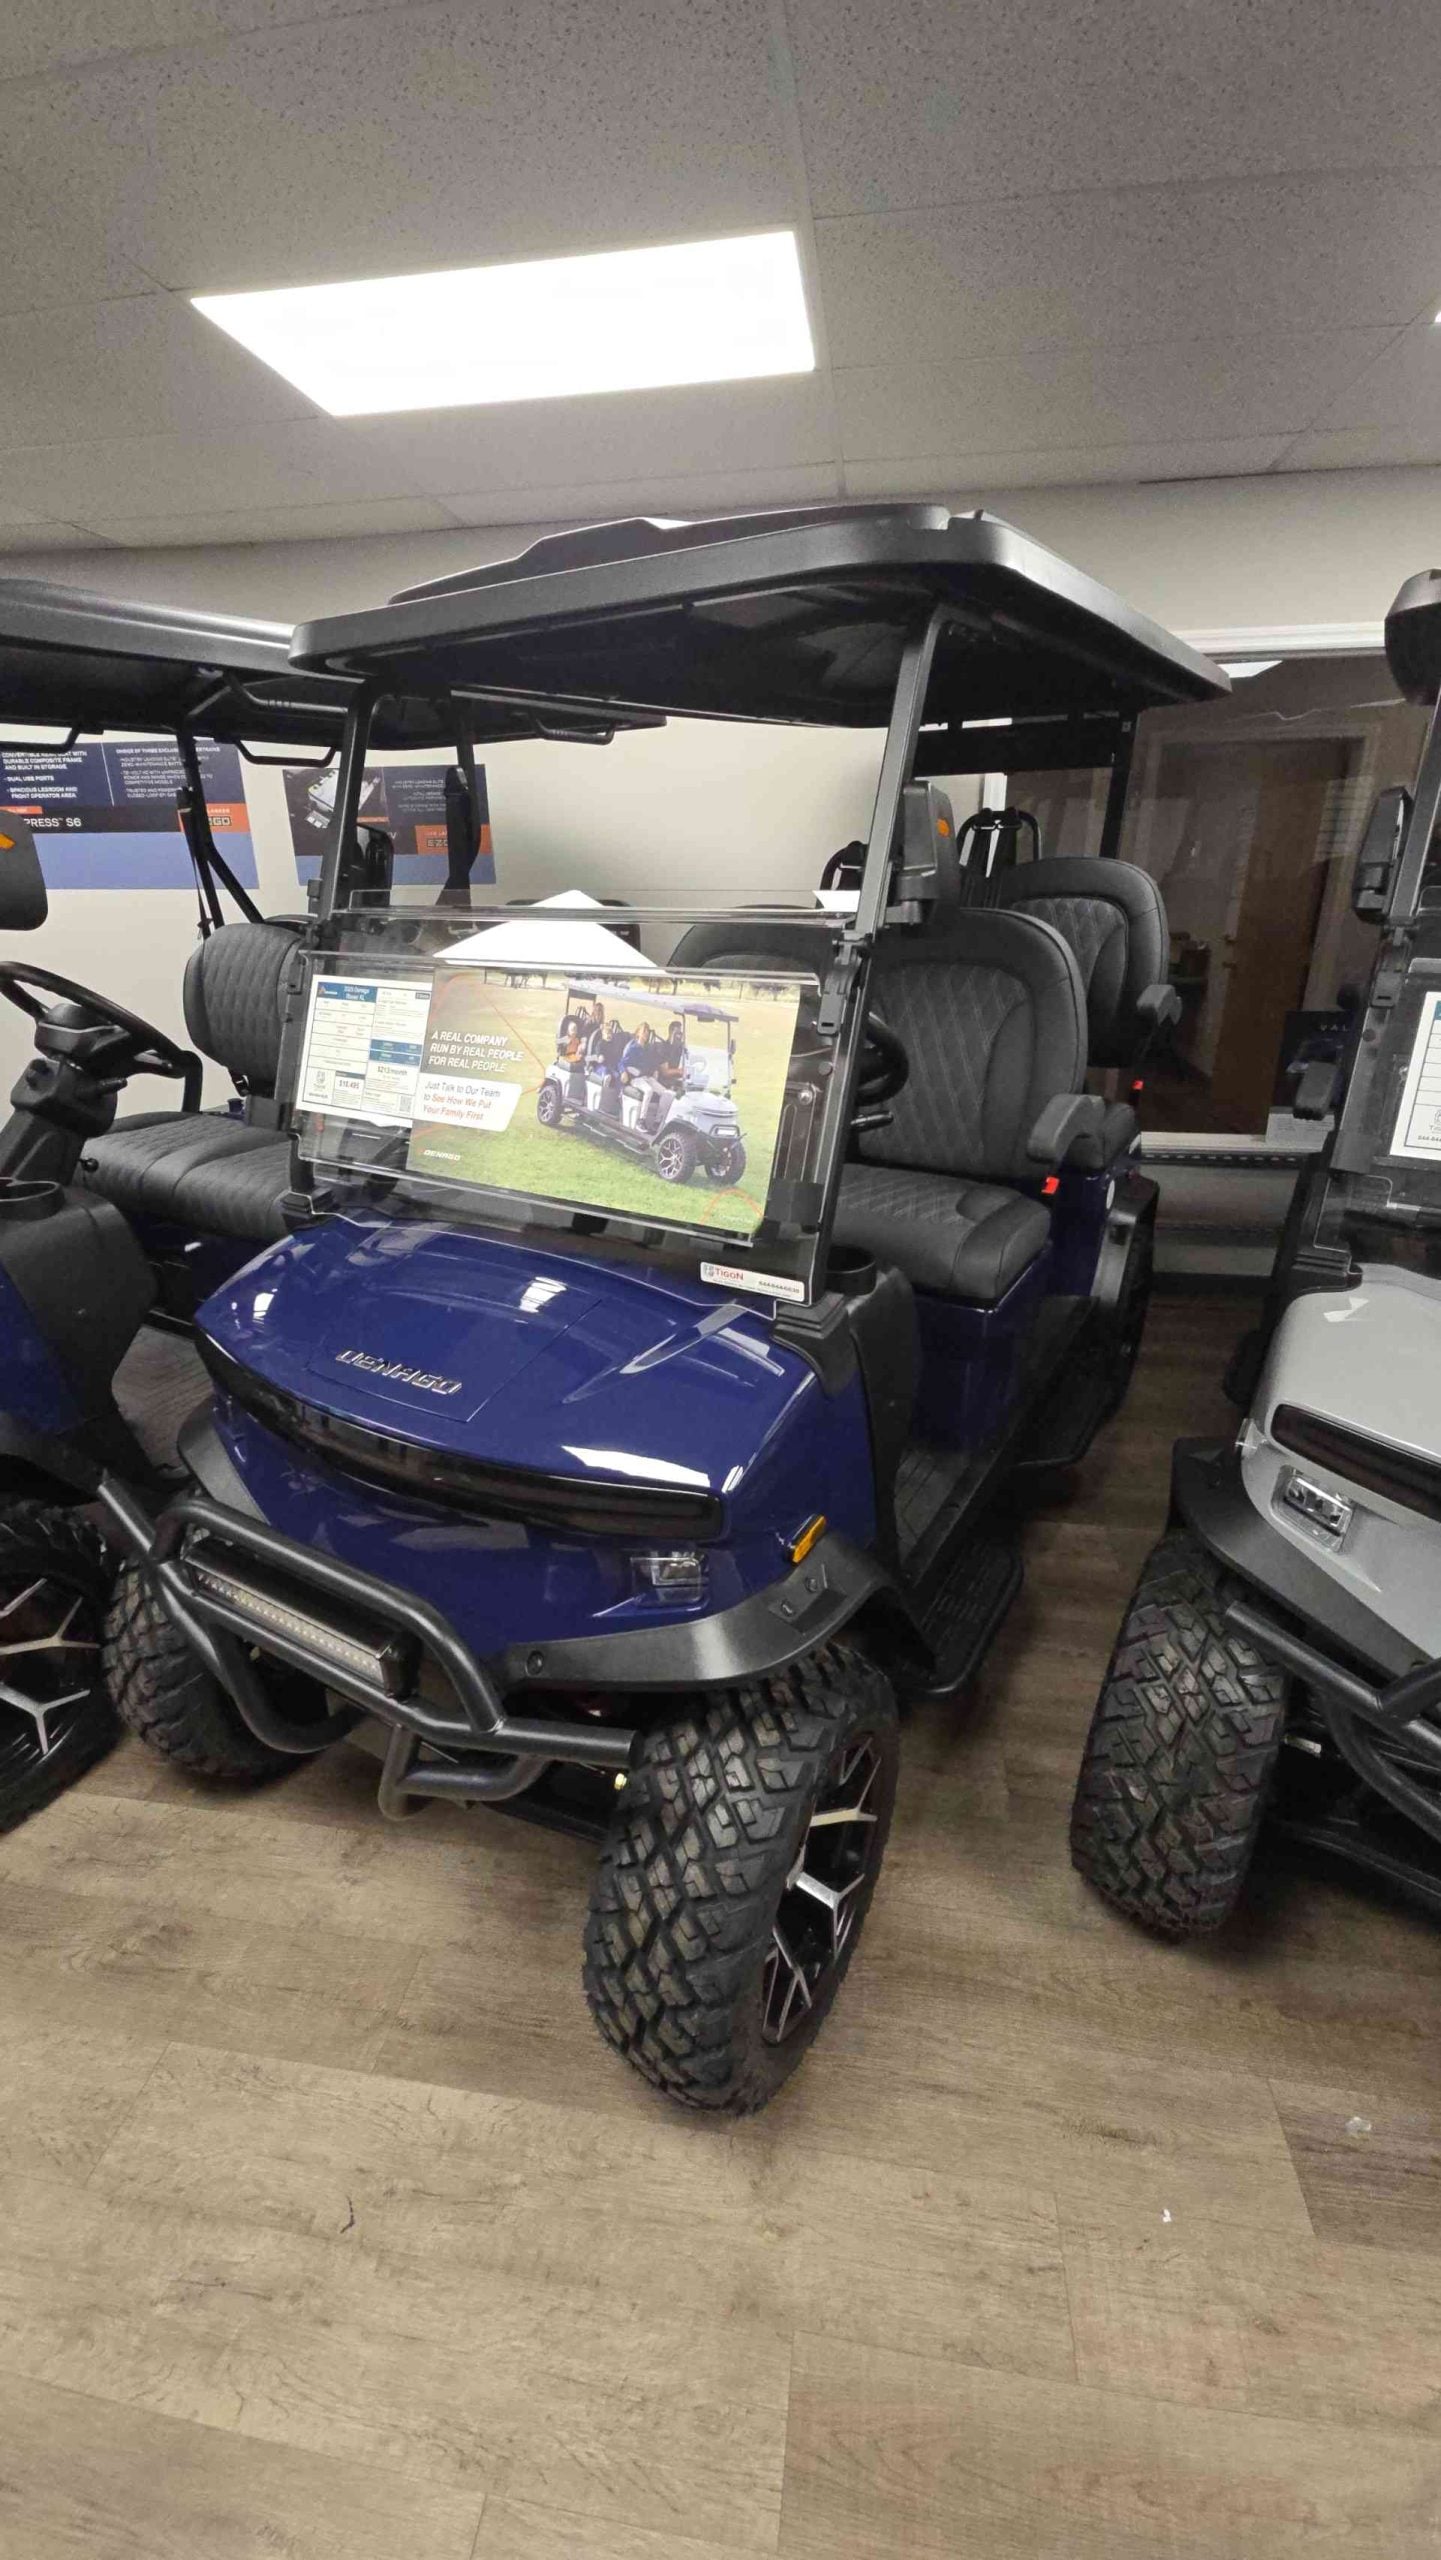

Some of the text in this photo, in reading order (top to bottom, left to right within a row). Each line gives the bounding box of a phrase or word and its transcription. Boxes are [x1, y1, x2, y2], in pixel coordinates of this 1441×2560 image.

[66, 818, 82, 827] S6
[209, 816, 231, 826] GO
[432, 1030, 508, 1047] A REAL COMPANY
[430, 1043, 449, 1053] RUN
[449, 1045, 462, 1055] BY
[462, 1046, 485, 1058] REAL
[487, 1049, 525, 1062] PEOPLE
[428, 1056, 508, 1072] FOR REAL PEOPLE
[424, 1081, 501, 1097] Just Talk to Our Team
[432, 1094, 444, 1103] See
[446, 1095, 463, 1105] How
[465, 1098, 477, 1107] We
[478, 1099, 492, 1108] Put
[424, 1104, 484, 1120] Your Family First
[424, 1149, 461, 1161] DENAGO
[335, 1350, 462, 1395] DENAGO
